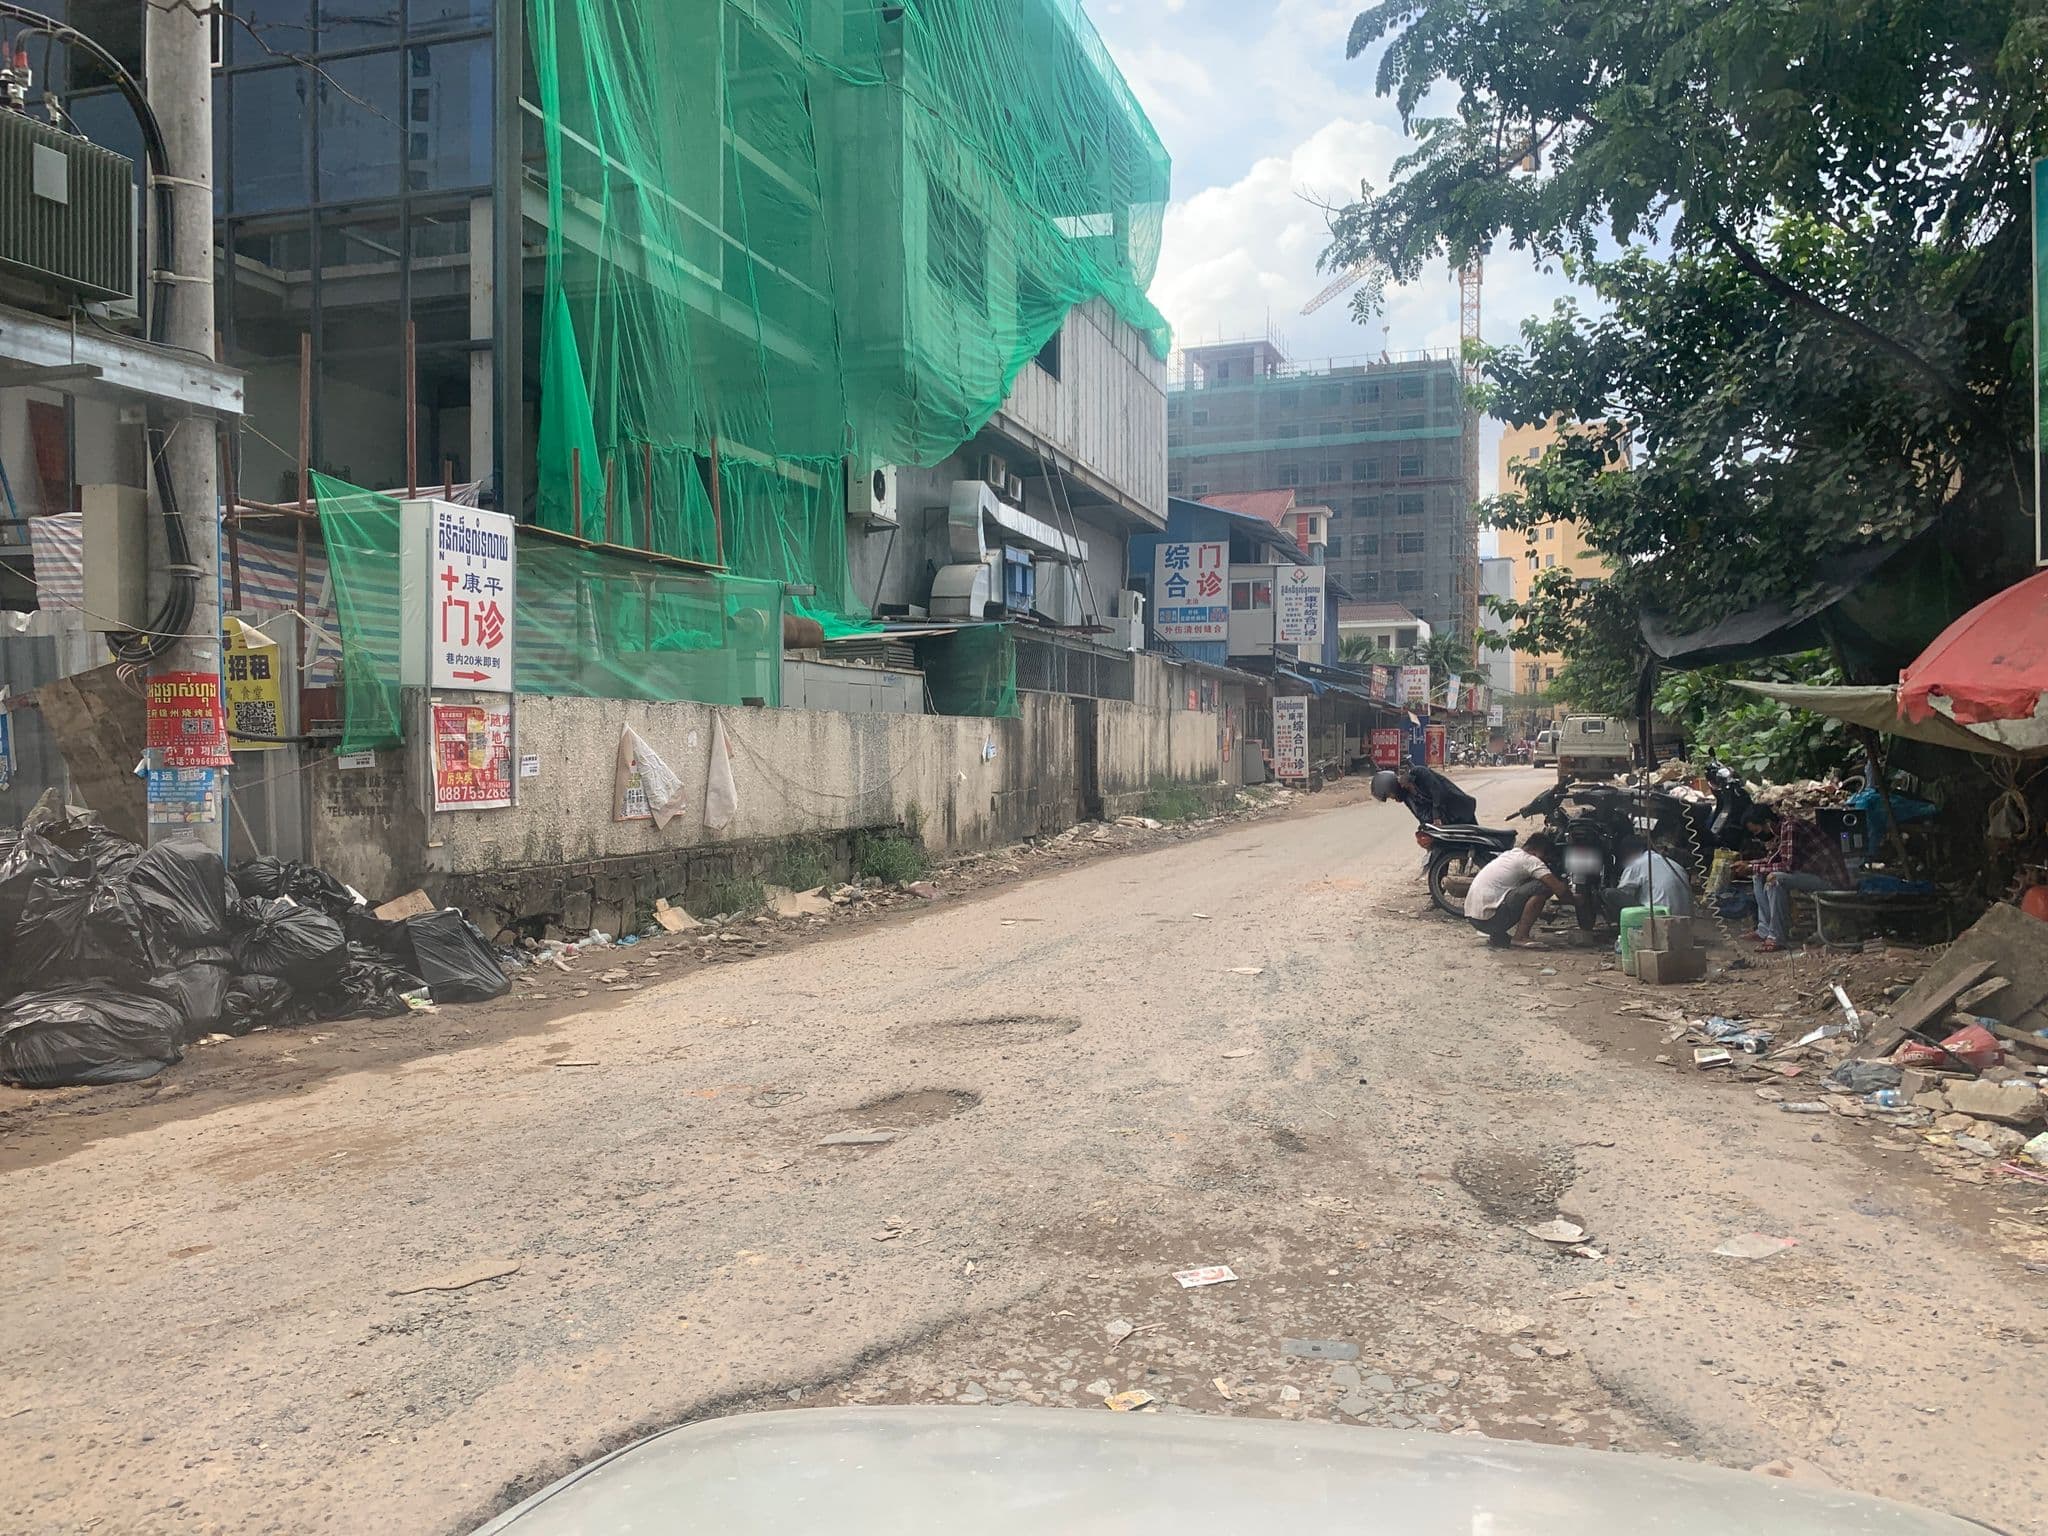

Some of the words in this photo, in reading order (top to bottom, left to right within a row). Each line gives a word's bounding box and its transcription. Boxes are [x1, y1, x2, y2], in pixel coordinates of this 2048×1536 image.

[462, 572, 504, 597] 康平
[1164, 545, 1190, 598] 综合
[1197, 544, 1222, 597] 门诊
[442, 595, 505, 650] 门诊
[223, 654, 271, 681] 招租
[446, 652, 501, 669] 巷内20米即到
